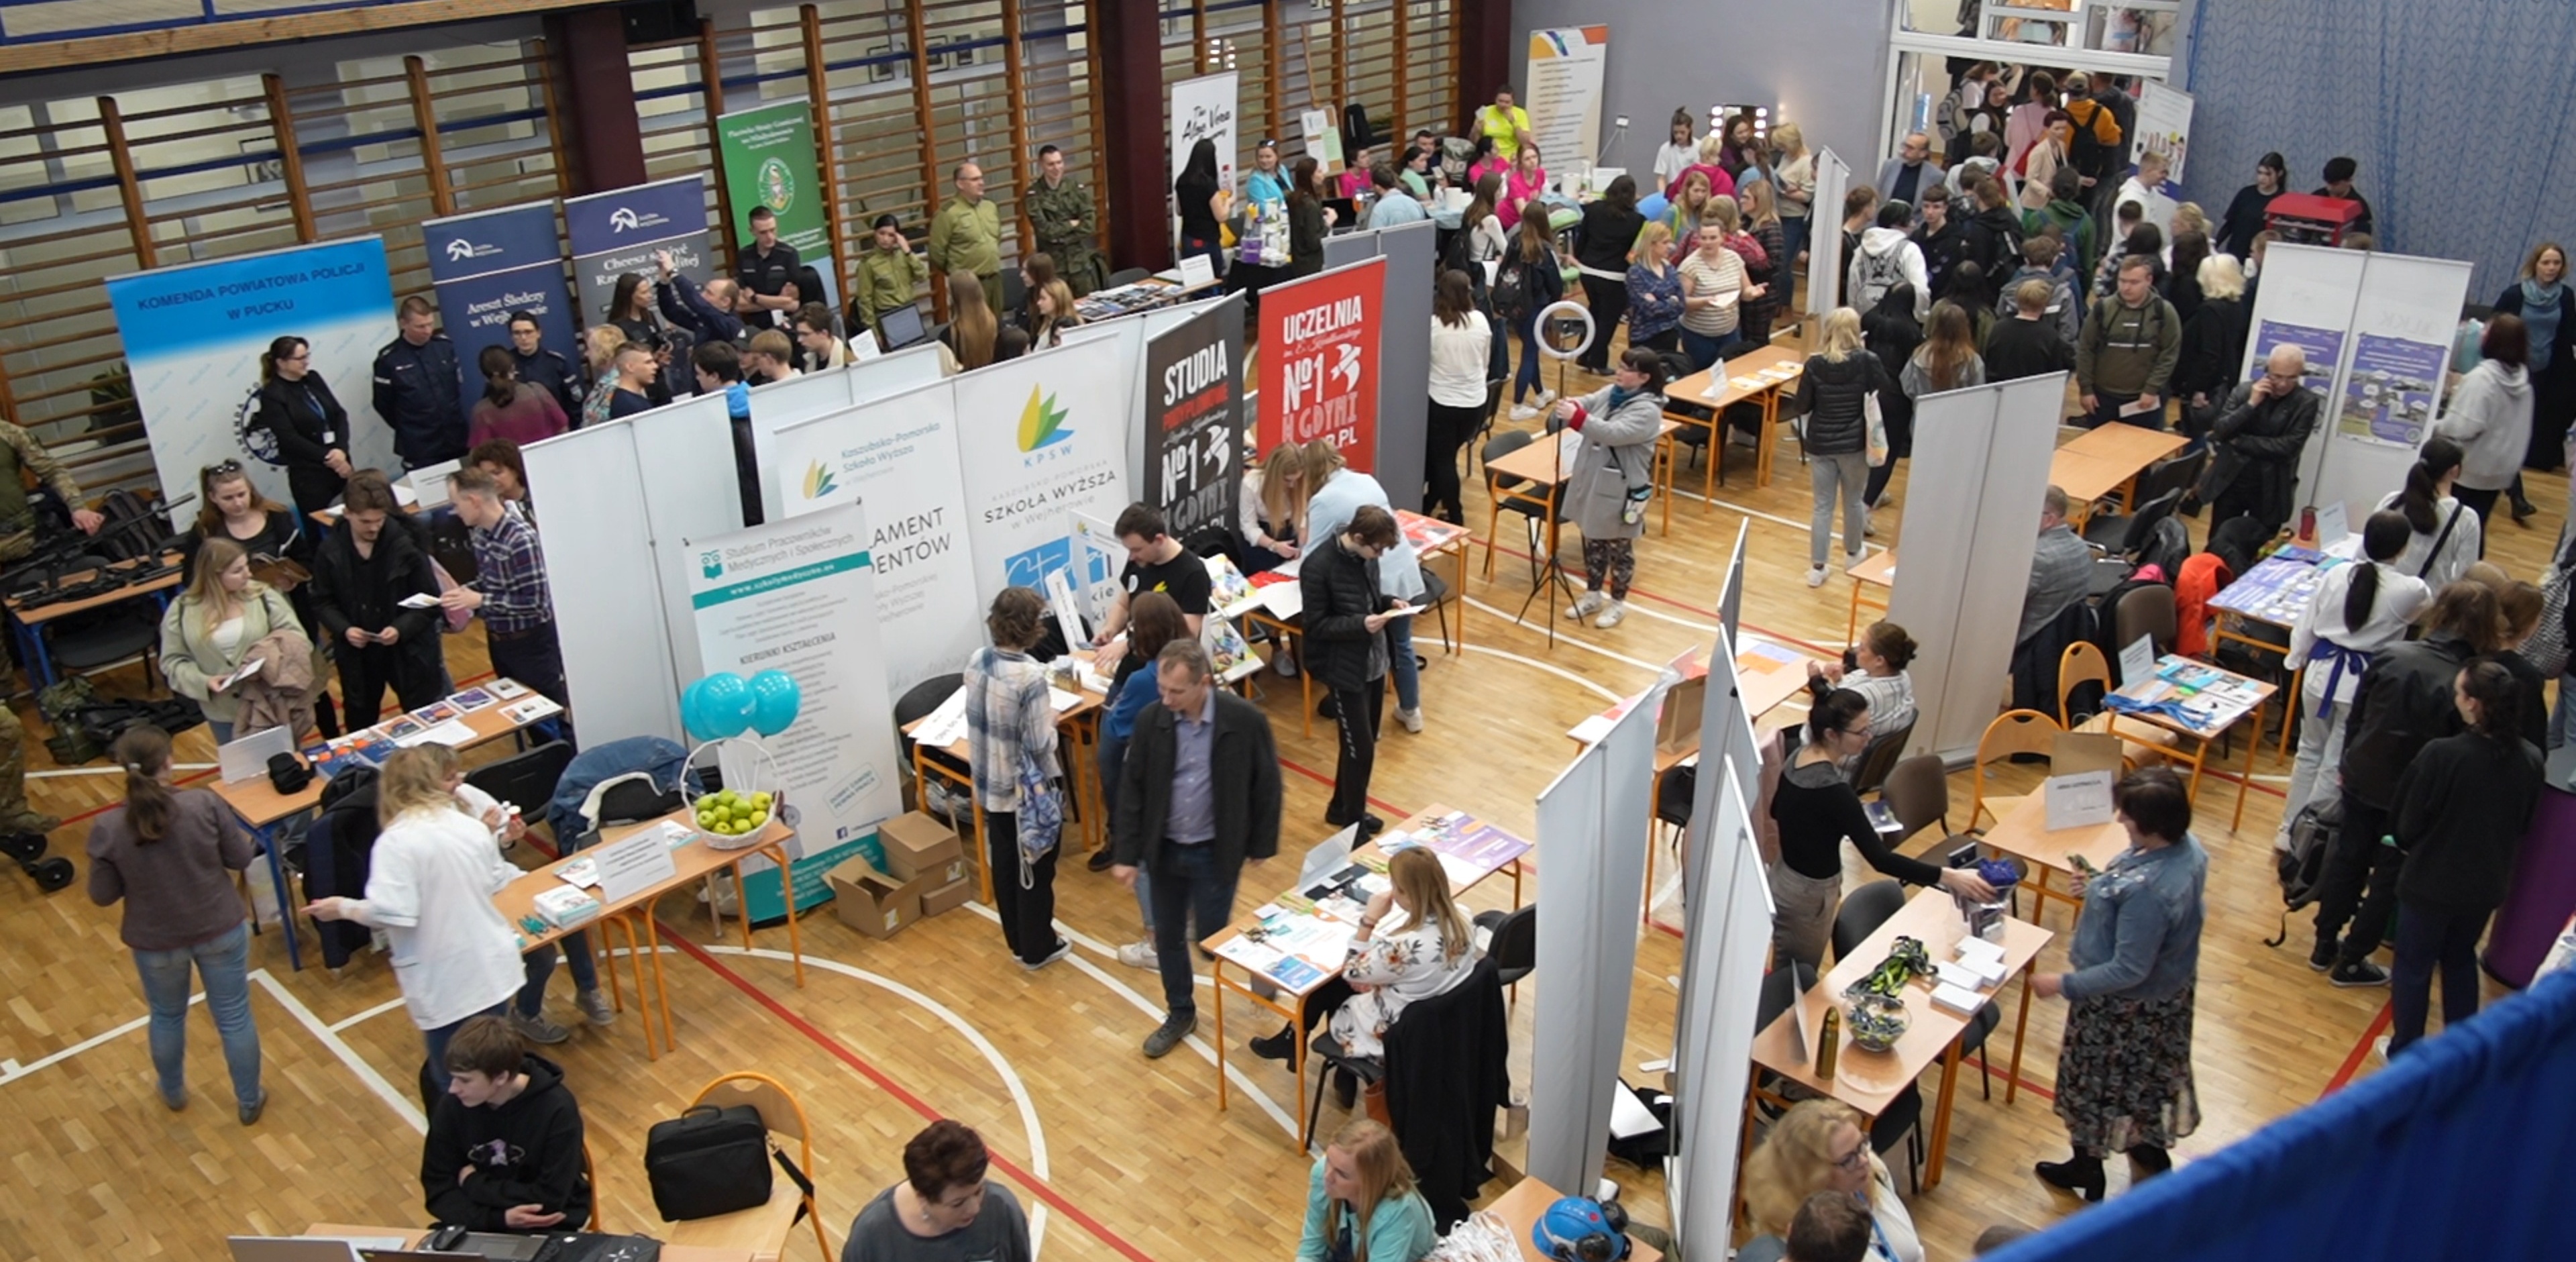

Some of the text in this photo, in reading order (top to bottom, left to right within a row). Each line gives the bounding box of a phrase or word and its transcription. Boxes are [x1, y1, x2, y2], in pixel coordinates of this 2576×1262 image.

[603, 255, 646, 270] Chcesz
[138, 262, 366, 311] KOMENDA POWIATOWA POLICJI
[467, 291, 546, 315] Areszt Śledczy
[227, 300, 294, 320] W PUCKU
[470, 319, 481, 327] w
[1283, 295, 1362, 344] UCZELNIA
[1164, 339, 1228, 406] STUDIA
[1299, 390, 1358, 438] GDYNI
[984, 470, 1116, 523] SZKOŁA WYŻSZA
[1025, 495, 1095, 525] Wejherowie
[1174, 478, 1228, 531] GDYNI
[724, 527, 833, 560] Studium Pracowników
[869, 507, 944, 549] AMENT
[728, 549, 788, 572] Medycznych
[795, 533, 855, 557] Społecznych
[739, 632, 837, 665] KIERUNKI KSZTAŁCENIA
